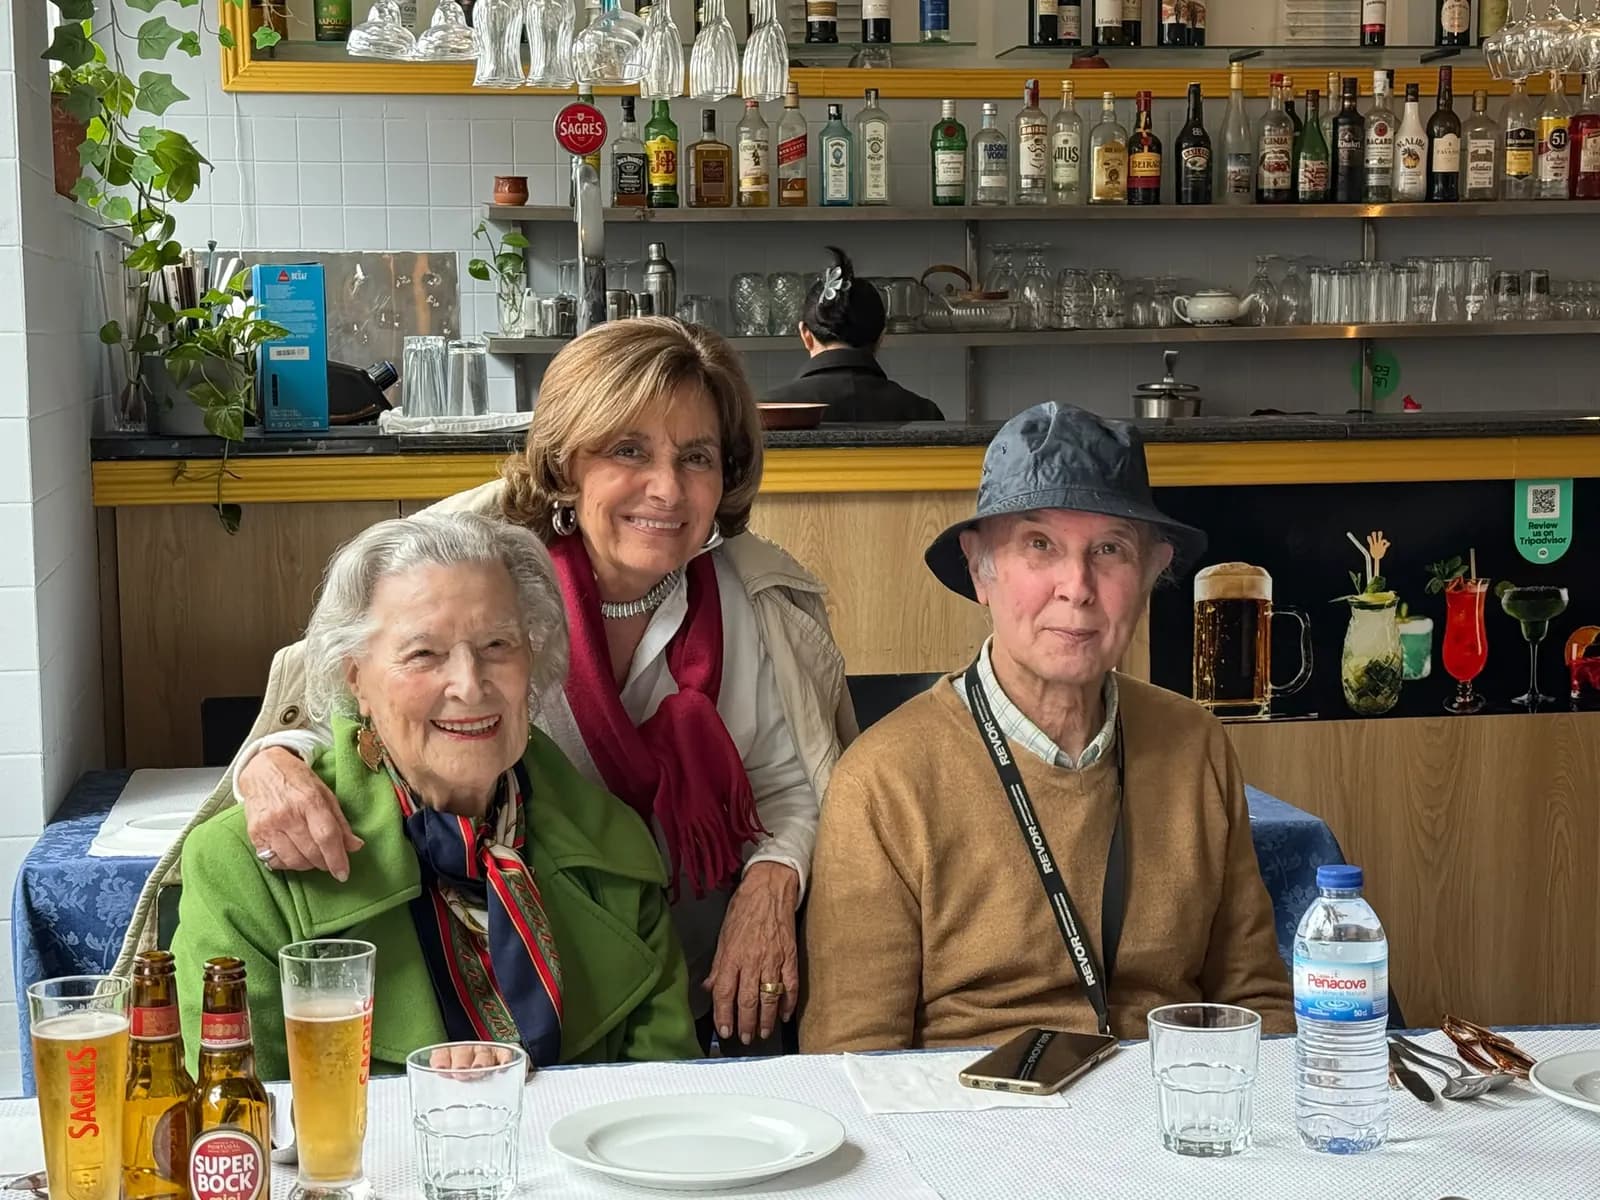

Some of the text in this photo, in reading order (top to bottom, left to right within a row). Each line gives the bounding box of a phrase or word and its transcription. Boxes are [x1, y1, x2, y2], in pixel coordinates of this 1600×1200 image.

[560, 121, 603, 136] SAGRES
[1551, 132, 1566, 146] 51
[1528, 521, 1559, 530] Review
[1519, 537, 1567, 546] Tripadvisor
[984, 720, 1011, 767] REVOR
[1026, 824, 1053, 875] REVOR
[1069, 936, 1096, 987] REVOR
[1307, 973, 1367, 990] Penacova
[66, 1045, 99, 1141] SAGRES
[195, 1153, 255, 1175] SUPER
[198, 1171, 253, 1193] BOCK
